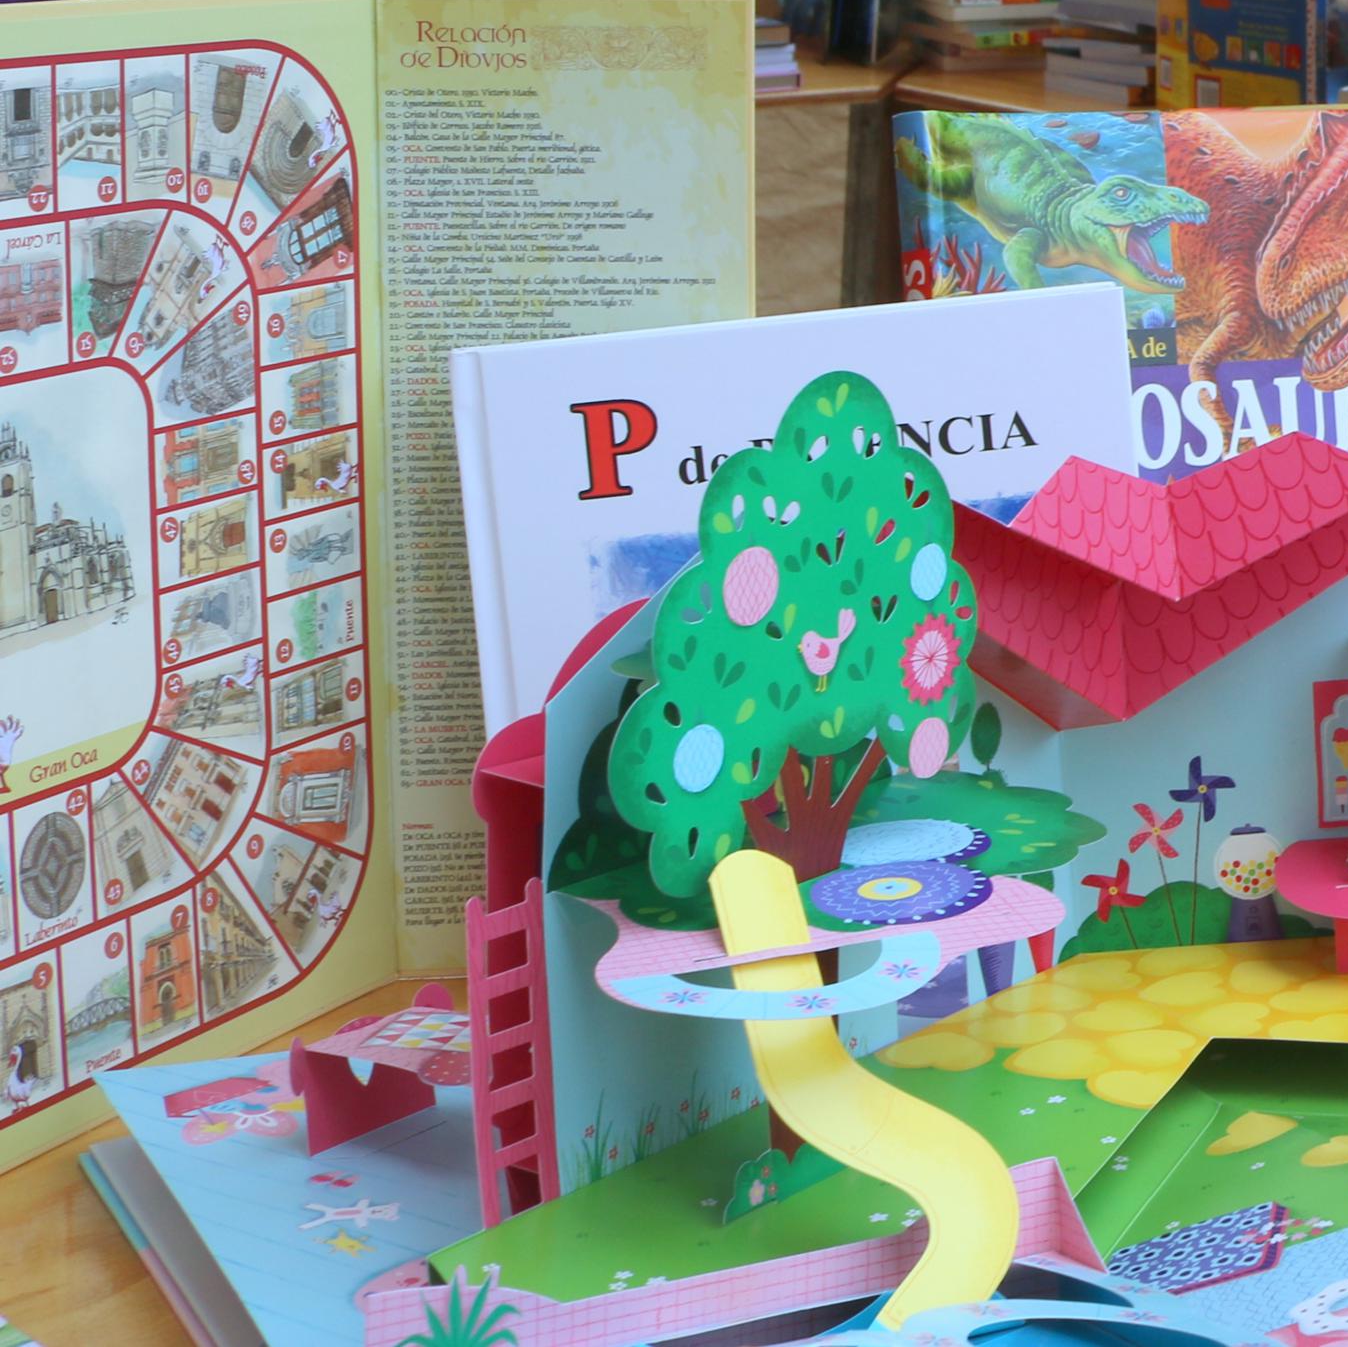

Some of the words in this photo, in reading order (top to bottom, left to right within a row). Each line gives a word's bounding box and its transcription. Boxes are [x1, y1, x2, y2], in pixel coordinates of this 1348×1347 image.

[1142, 337, 1168, 357] de
[570, 399, 659, 501] P
[29, 759, 68, 784] Gran
[71, 747, 99, 771] Oca
